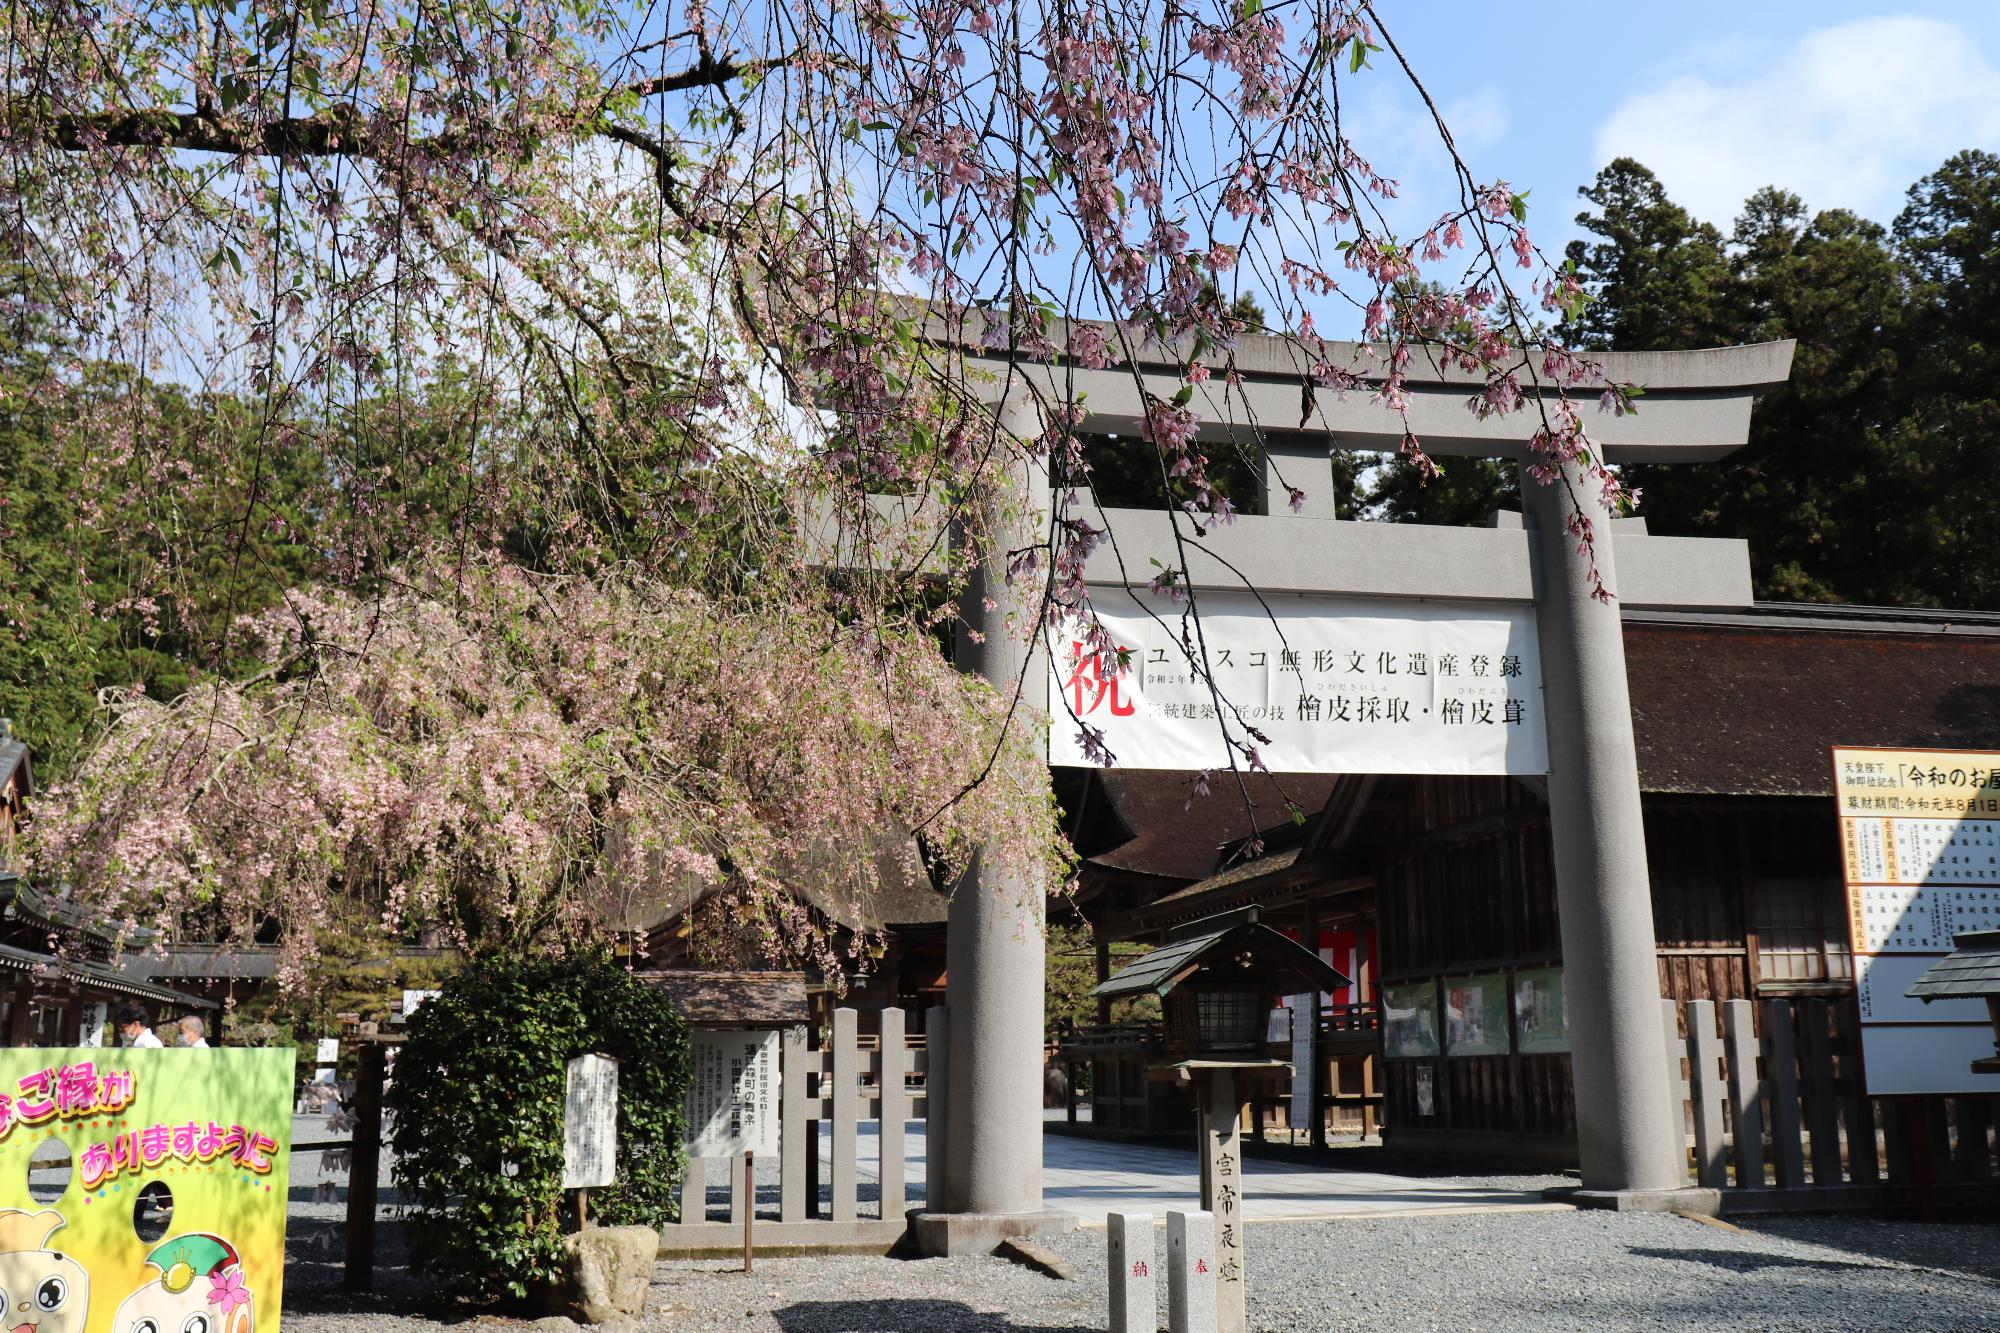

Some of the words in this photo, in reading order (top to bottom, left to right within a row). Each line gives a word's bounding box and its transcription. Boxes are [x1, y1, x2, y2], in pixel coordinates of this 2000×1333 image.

[1062, 640, 1135, 716] 祝
[1845, 762, 1885, 774] 天皇陛下
[1846, 776, 1897, 788] 御即位記念
[80, 1120, 279, 1189] ありますように
[1132, 1261, 1148, 1277] 納
[1195, 1259, 1208, 1275] 奉
